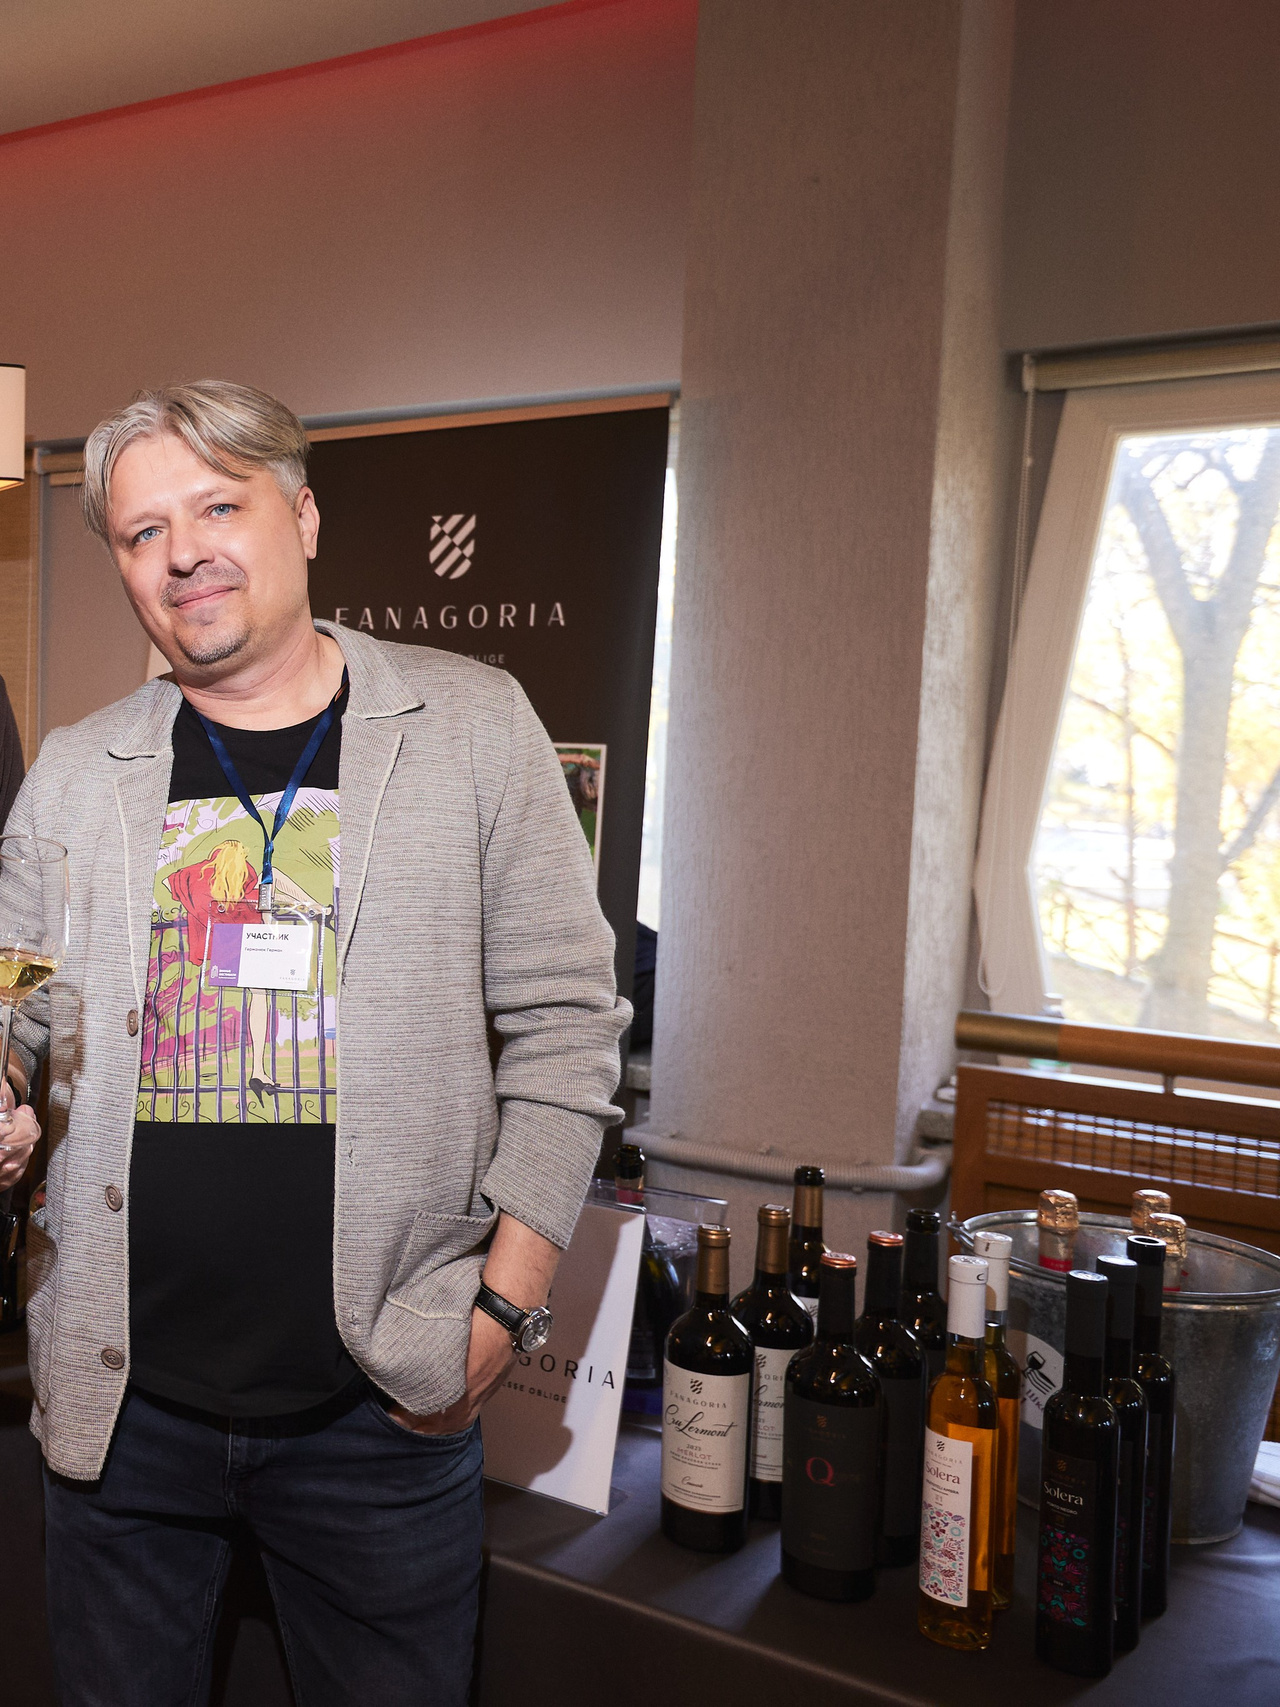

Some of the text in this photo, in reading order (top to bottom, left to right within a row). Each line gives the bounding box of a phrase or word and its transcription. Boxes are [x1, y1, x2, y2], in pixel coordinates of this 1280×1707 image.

[334, 602, 566, 630] FANAGORIA
[518, 1354, 615, 1389] GORIA
[528, 1387, 567, 1403] OBLIGE
[670, 1390, 727, 1409] FANAGORIA
[675, 1411, 738, 1441] Lermont
[676, 1447, 712, 1460] MERLOT
[805, 1456, 836, 1487] Q
[925, 1461, 961, 1485] Solera
[1043, 1481, 1084, 1506] Solera
